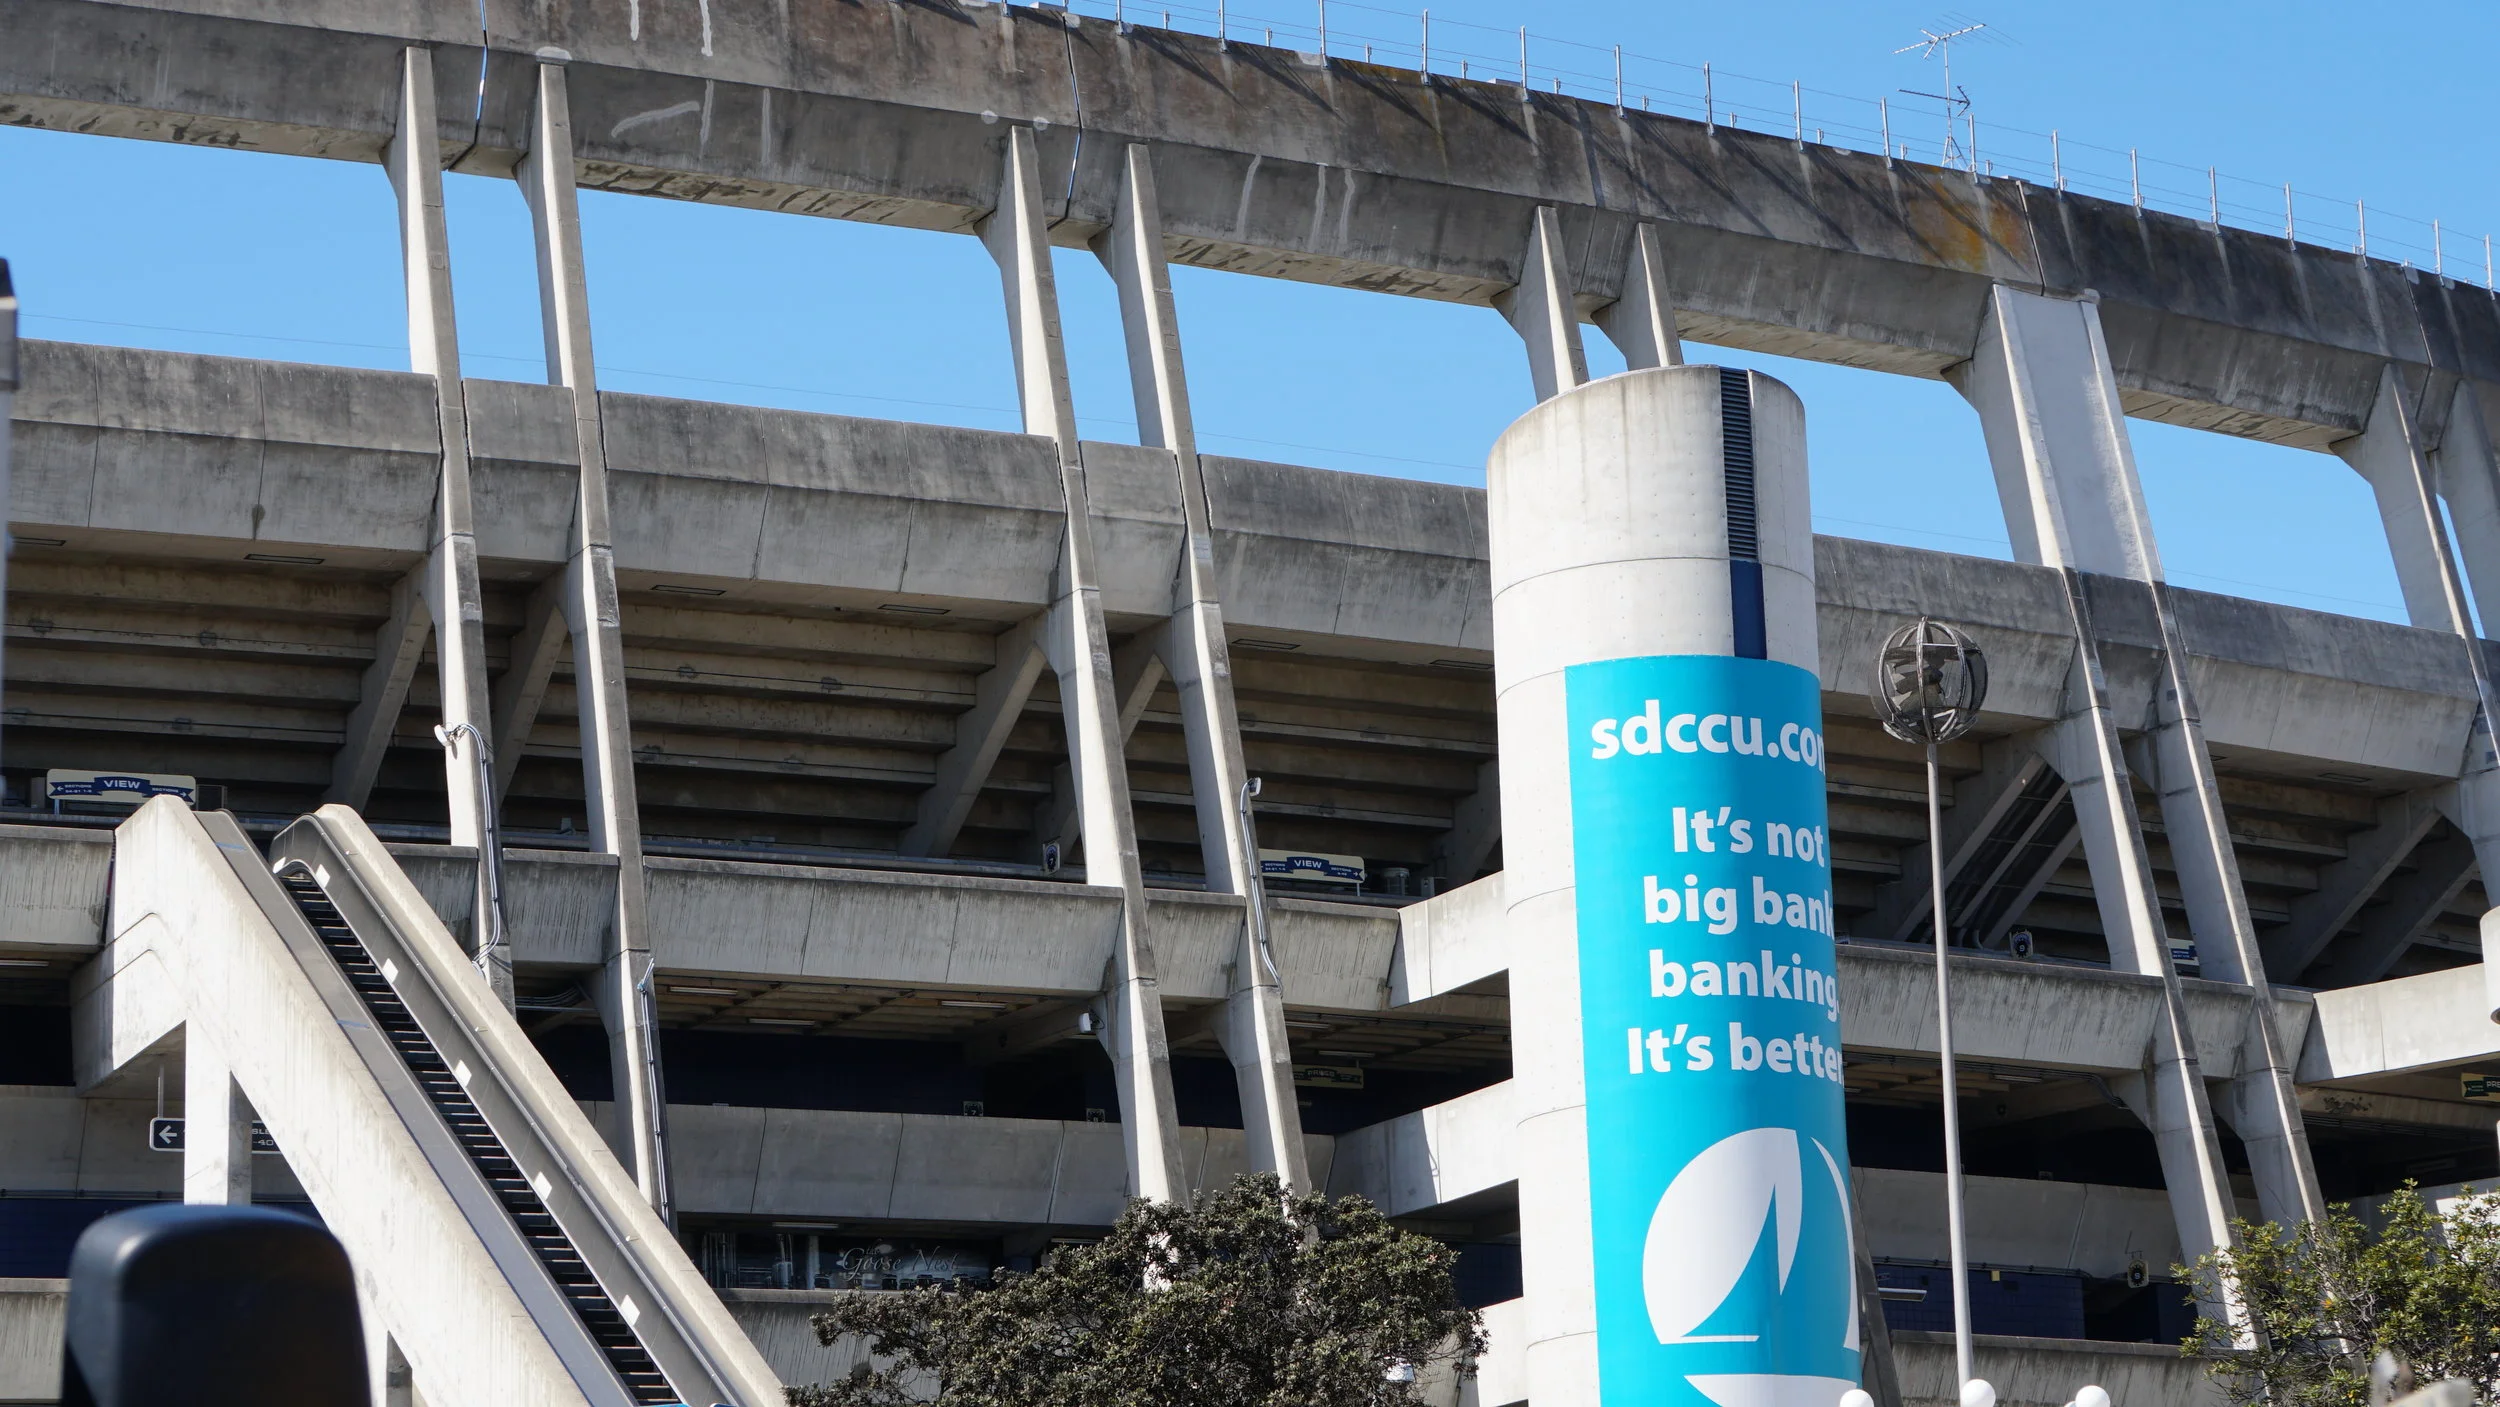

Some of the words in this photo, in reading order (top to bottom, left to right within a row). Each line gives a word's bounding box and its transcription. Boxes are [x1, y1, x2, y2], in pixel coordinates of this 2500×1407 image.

[103, 780, 140, 789] VIEW
[1672, 806, 1752, 853] It's
[1767, 822, 1825, 867] not
[1294, 860, 1322, 869] VIEW
[1643, 874, 1738, 935] big
[1752, 876, 1835, 940] bank
[1627, 1022, 1714, 1075] It's
[842, 1247, 903, 1281] Goose
[912, 1245, 960, 1272] Nest
